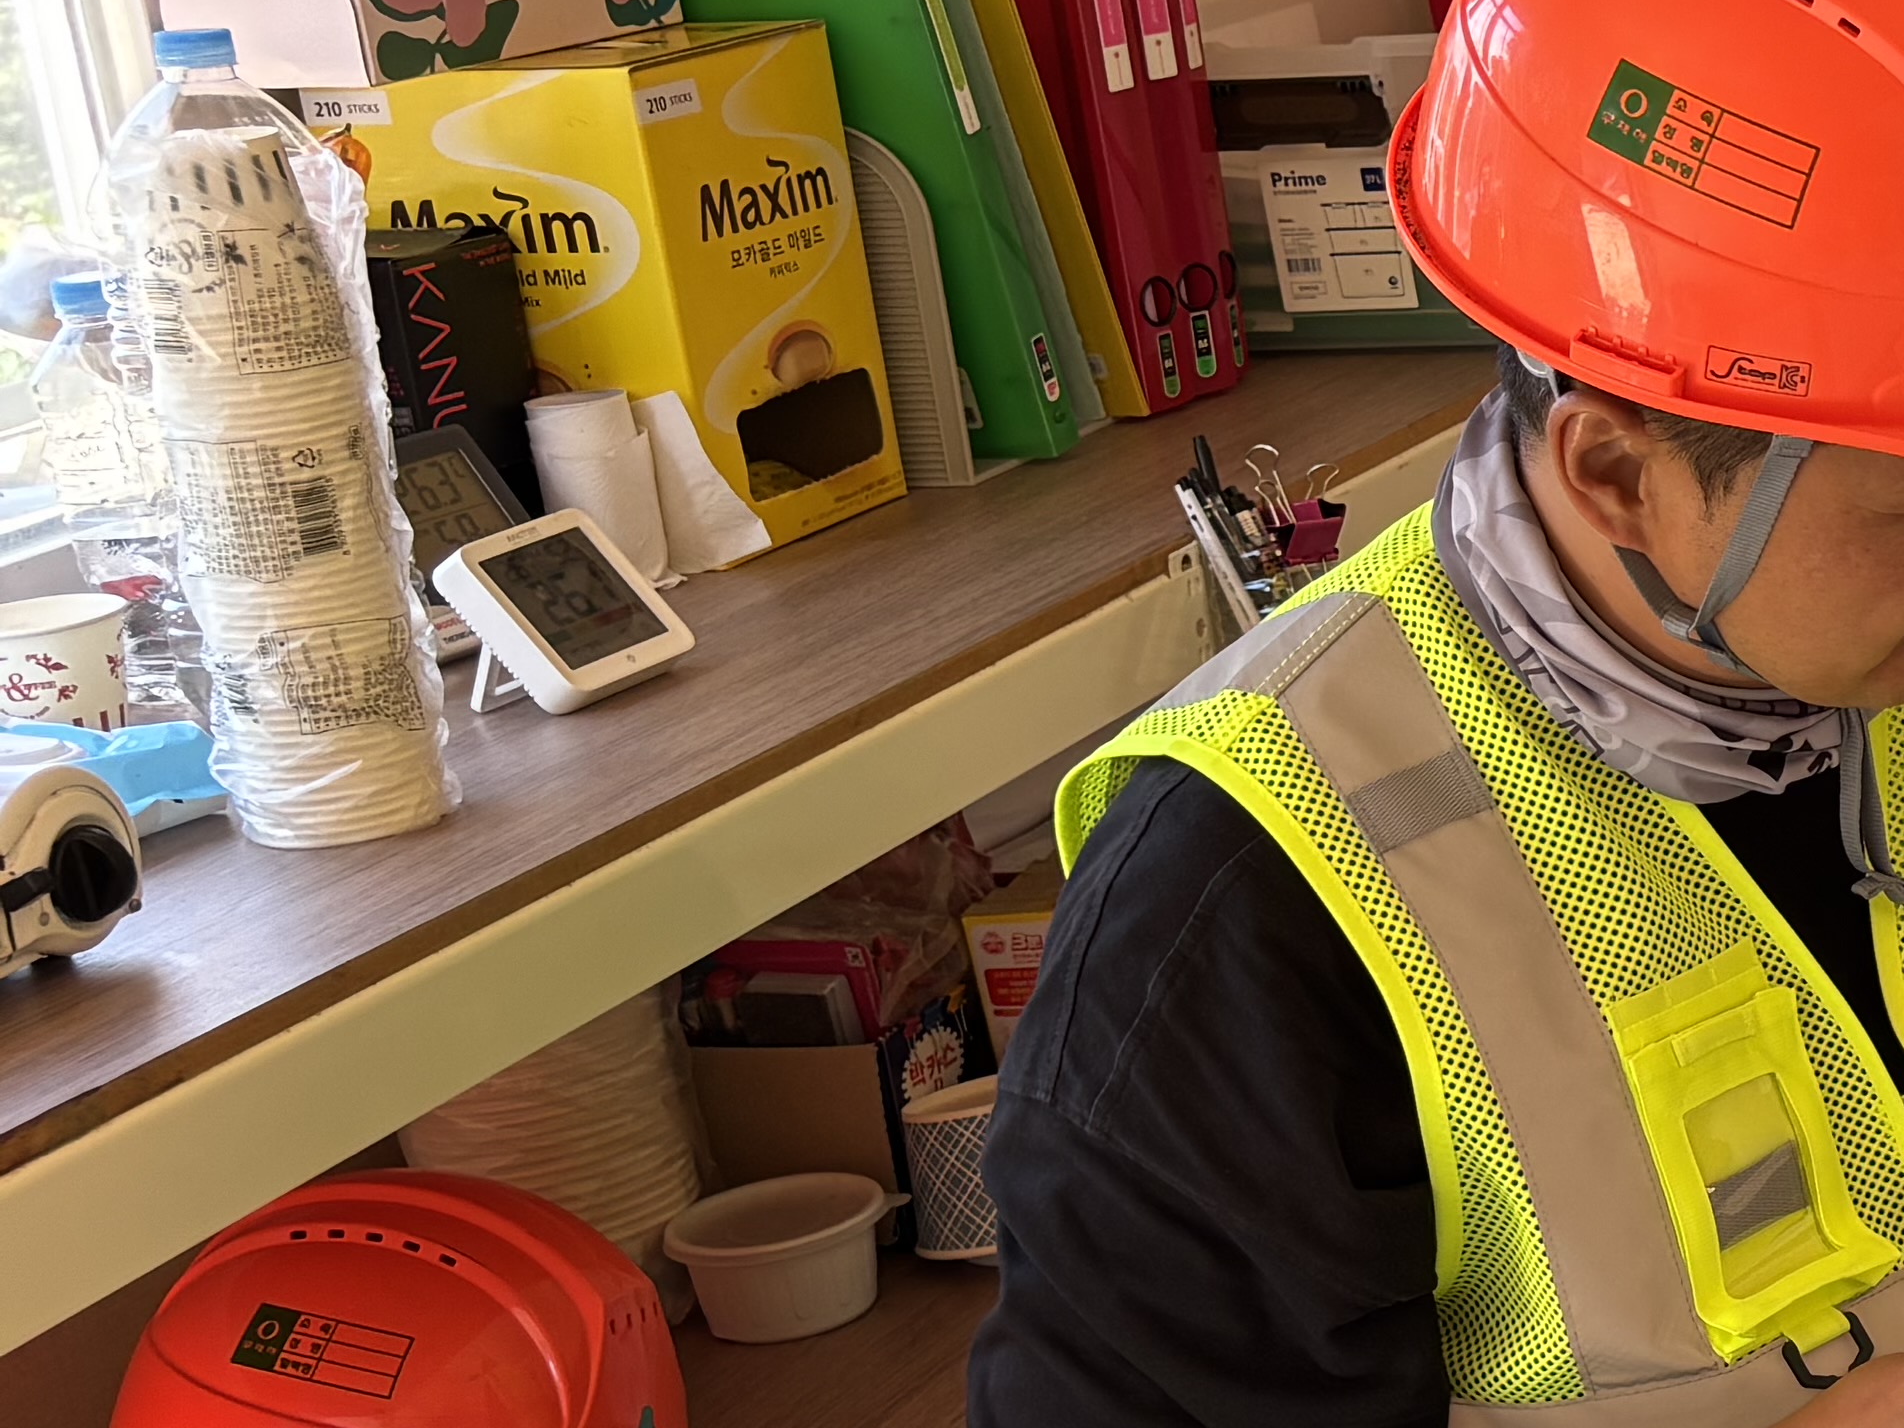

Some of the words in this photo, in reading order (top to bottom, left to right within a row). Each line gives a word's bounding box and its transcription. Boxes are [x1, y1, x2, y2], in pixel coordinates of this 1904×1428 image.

[314, 99, 342, 118] 210
[346, 102, 380, 116] STICKS
[646, 96, 667, 114] 210
[669, 92, 693, 108] STICKS
[1270, 170, 1327, 188] Prime
[699, 157, 835, 242] Maxim
[731, 234, 786, 270] 모카골드
[788, 224, 826, 253] 마일드
